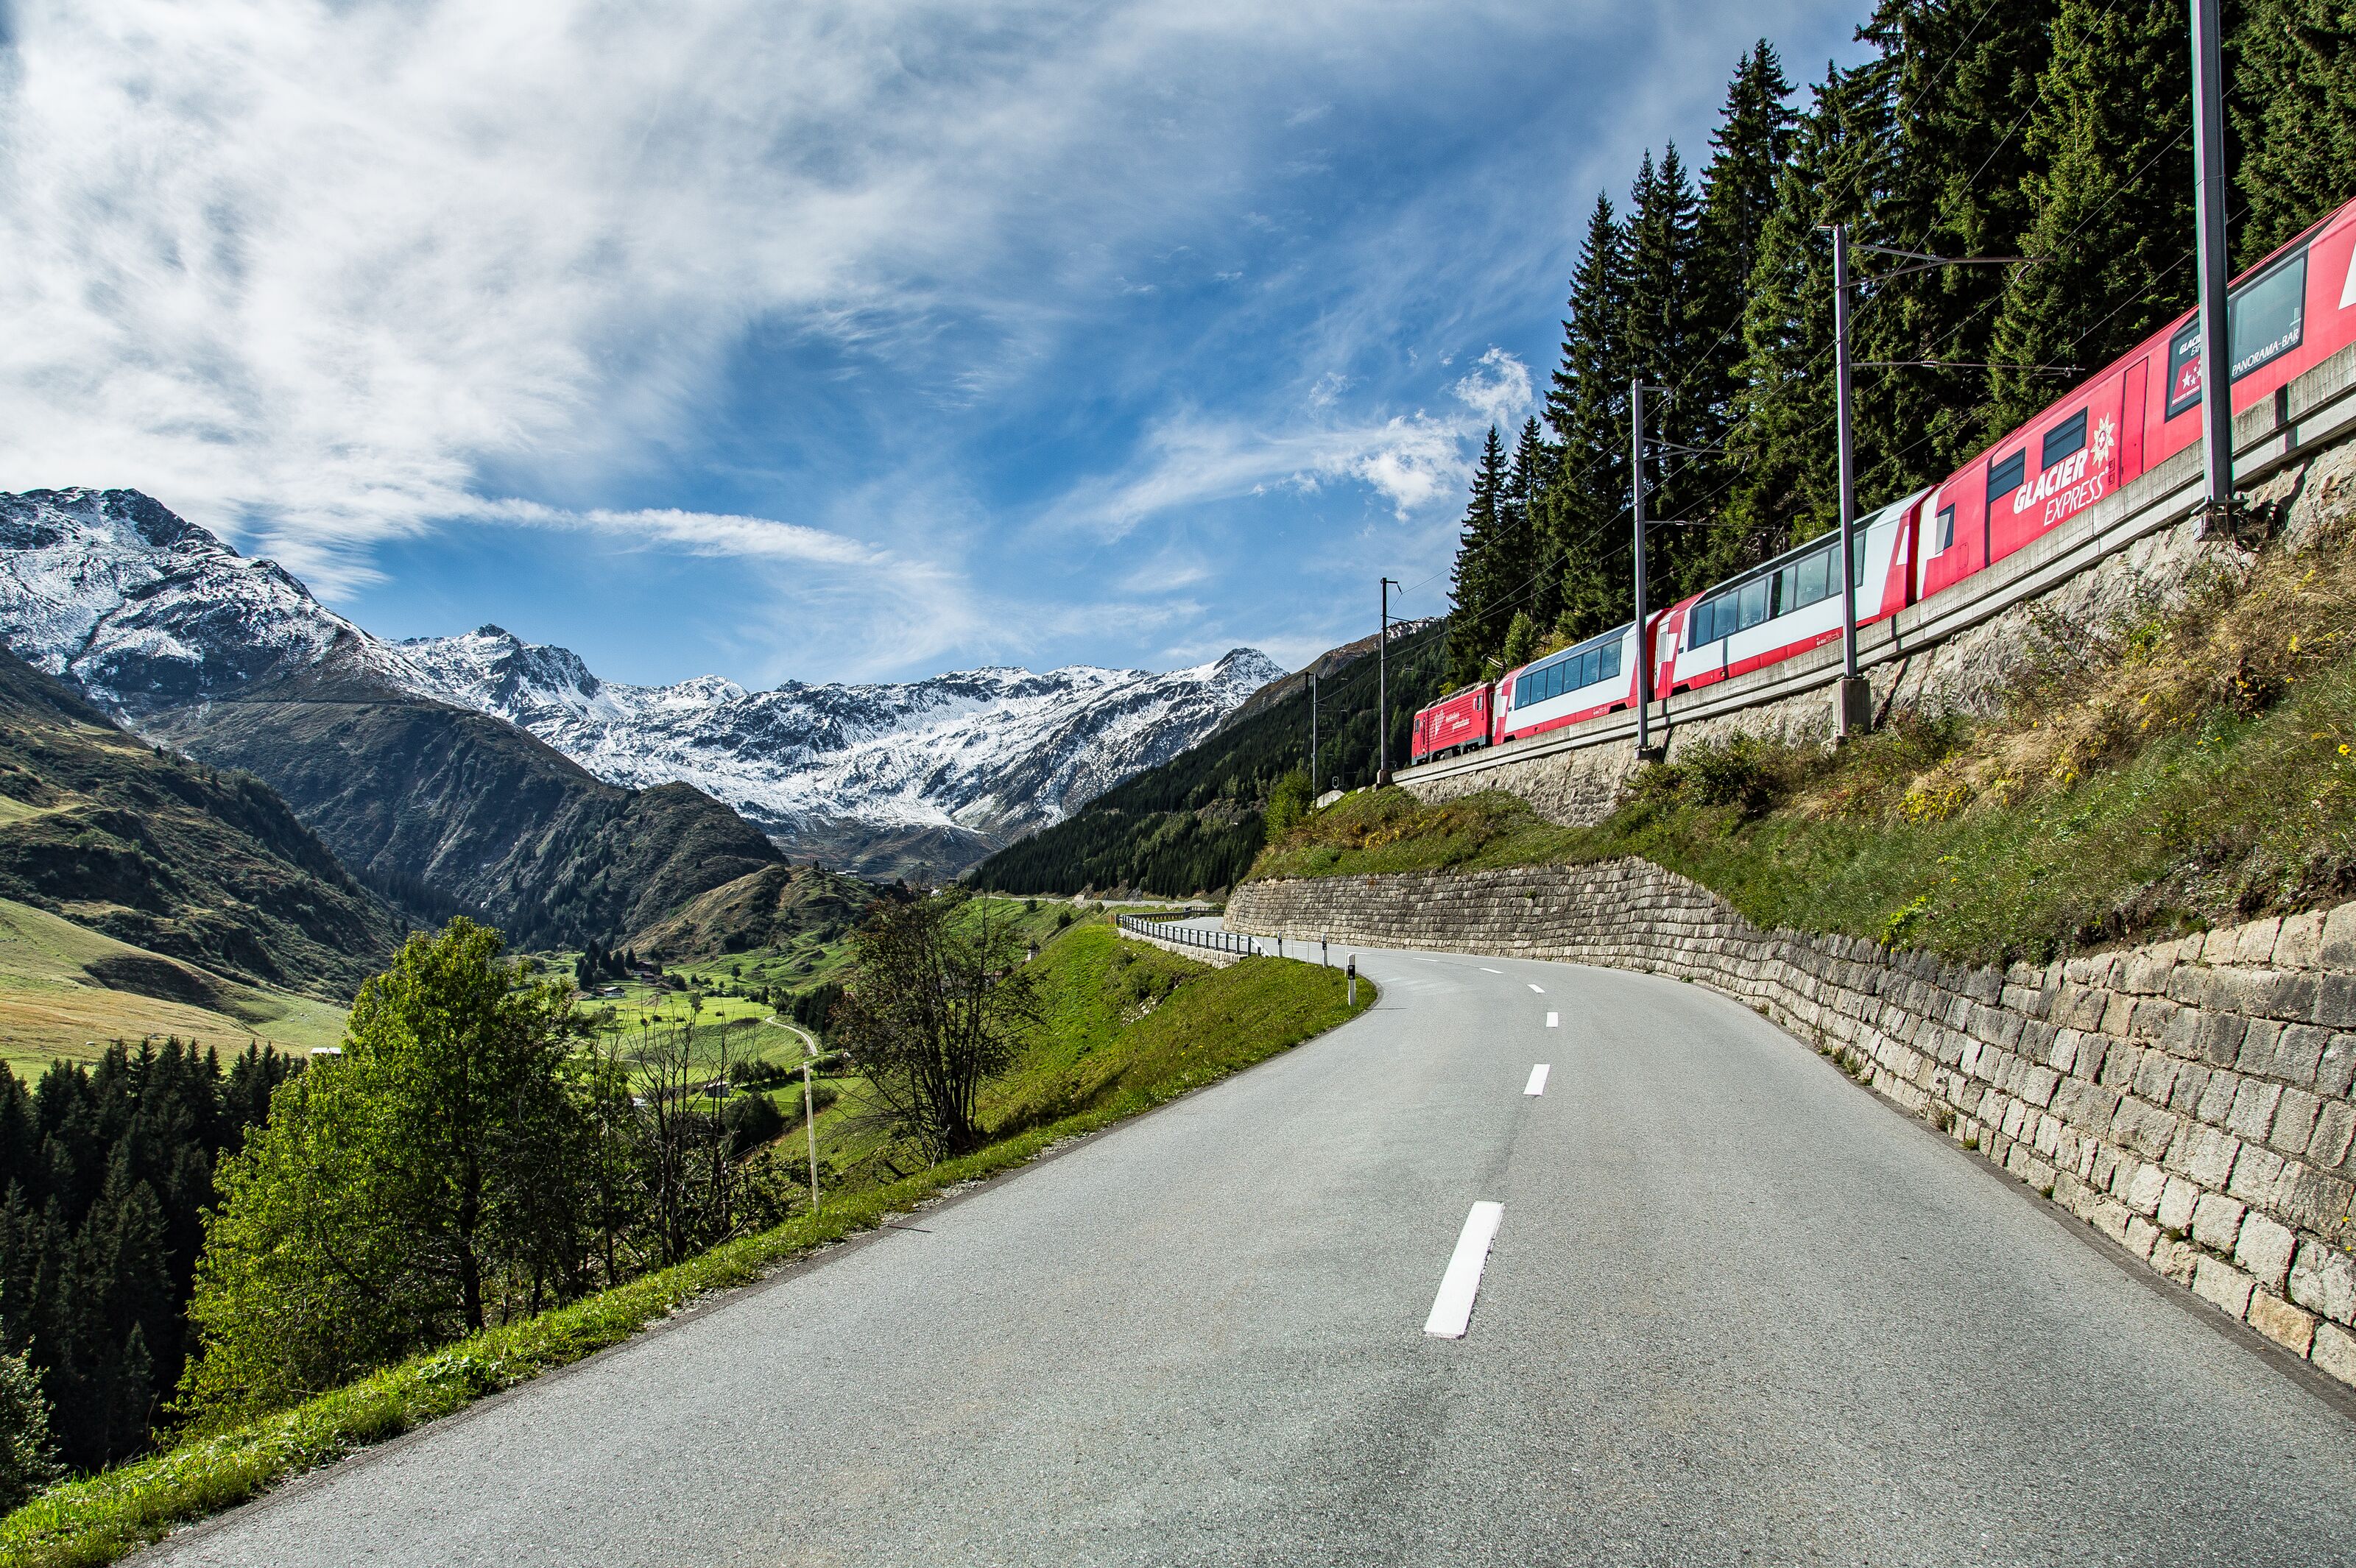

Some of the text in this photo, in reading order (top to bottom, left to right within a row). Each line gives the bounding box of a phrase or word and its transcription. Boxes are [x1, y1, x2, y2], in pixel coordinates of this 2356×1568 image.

[2179, 333, 2201, 356] GLACI
[2232, 328, 2299, 377] PANORAMA-BAR
[2013, 448, 2089, 515] GLACIER
[2043, 472, 2106, 526] EXPRESS
